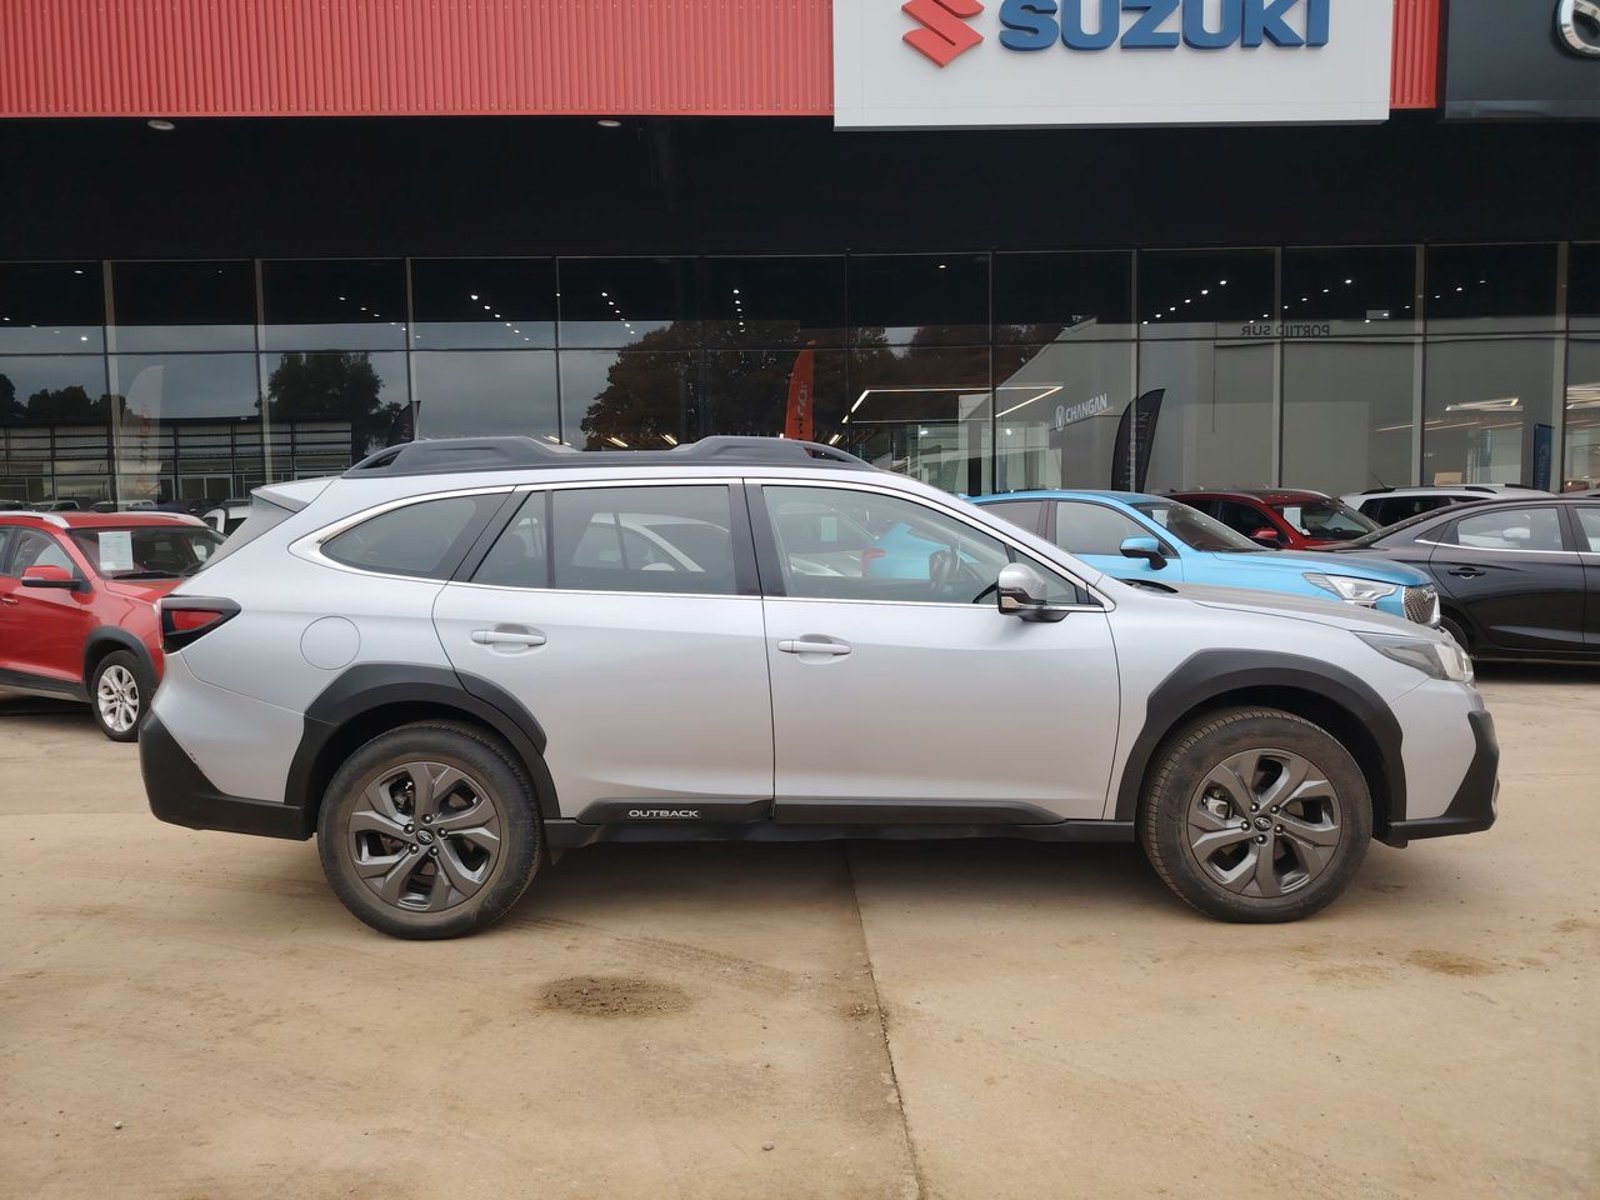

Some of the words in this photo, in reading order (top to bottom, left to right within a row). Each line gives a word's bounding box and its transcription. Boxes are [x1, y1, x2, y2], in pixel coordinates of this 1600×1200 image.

[998, 0, 1330, 51] SUZUKI
[1065, 392, 1107, 423] CHANGAN
[628, 809, 699, 818] OUTBACK
